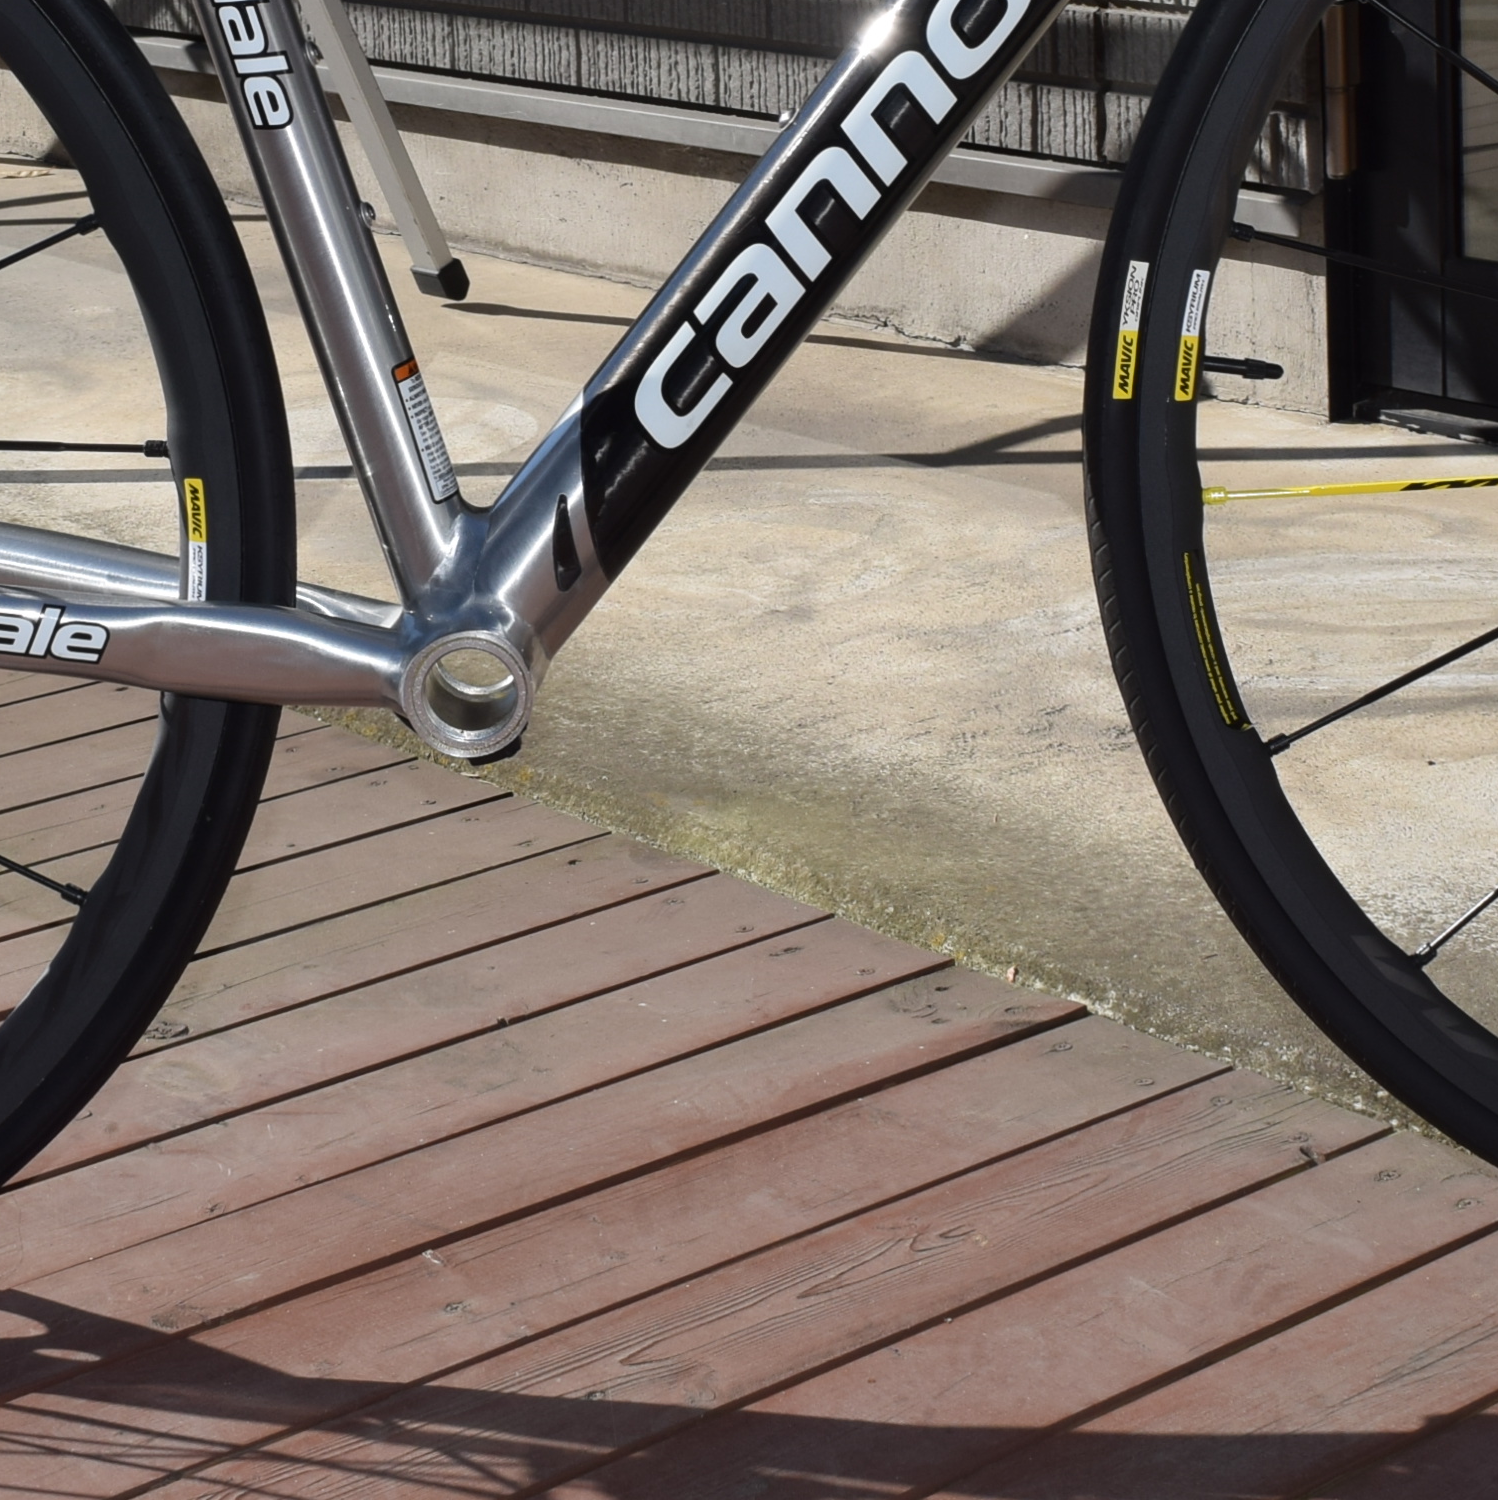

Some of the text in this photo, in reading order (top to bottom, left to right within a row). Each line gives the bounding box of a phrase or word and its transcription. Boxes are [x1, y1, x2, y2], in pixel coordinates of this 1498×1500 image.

[1185, 274, 1201, 333] KSYRIUM
[1119, 335, 1133, 394] MAVIC
[1179, 340, 1194, 396] MAVIC
[189, 483, 202, 538] MAVIC
